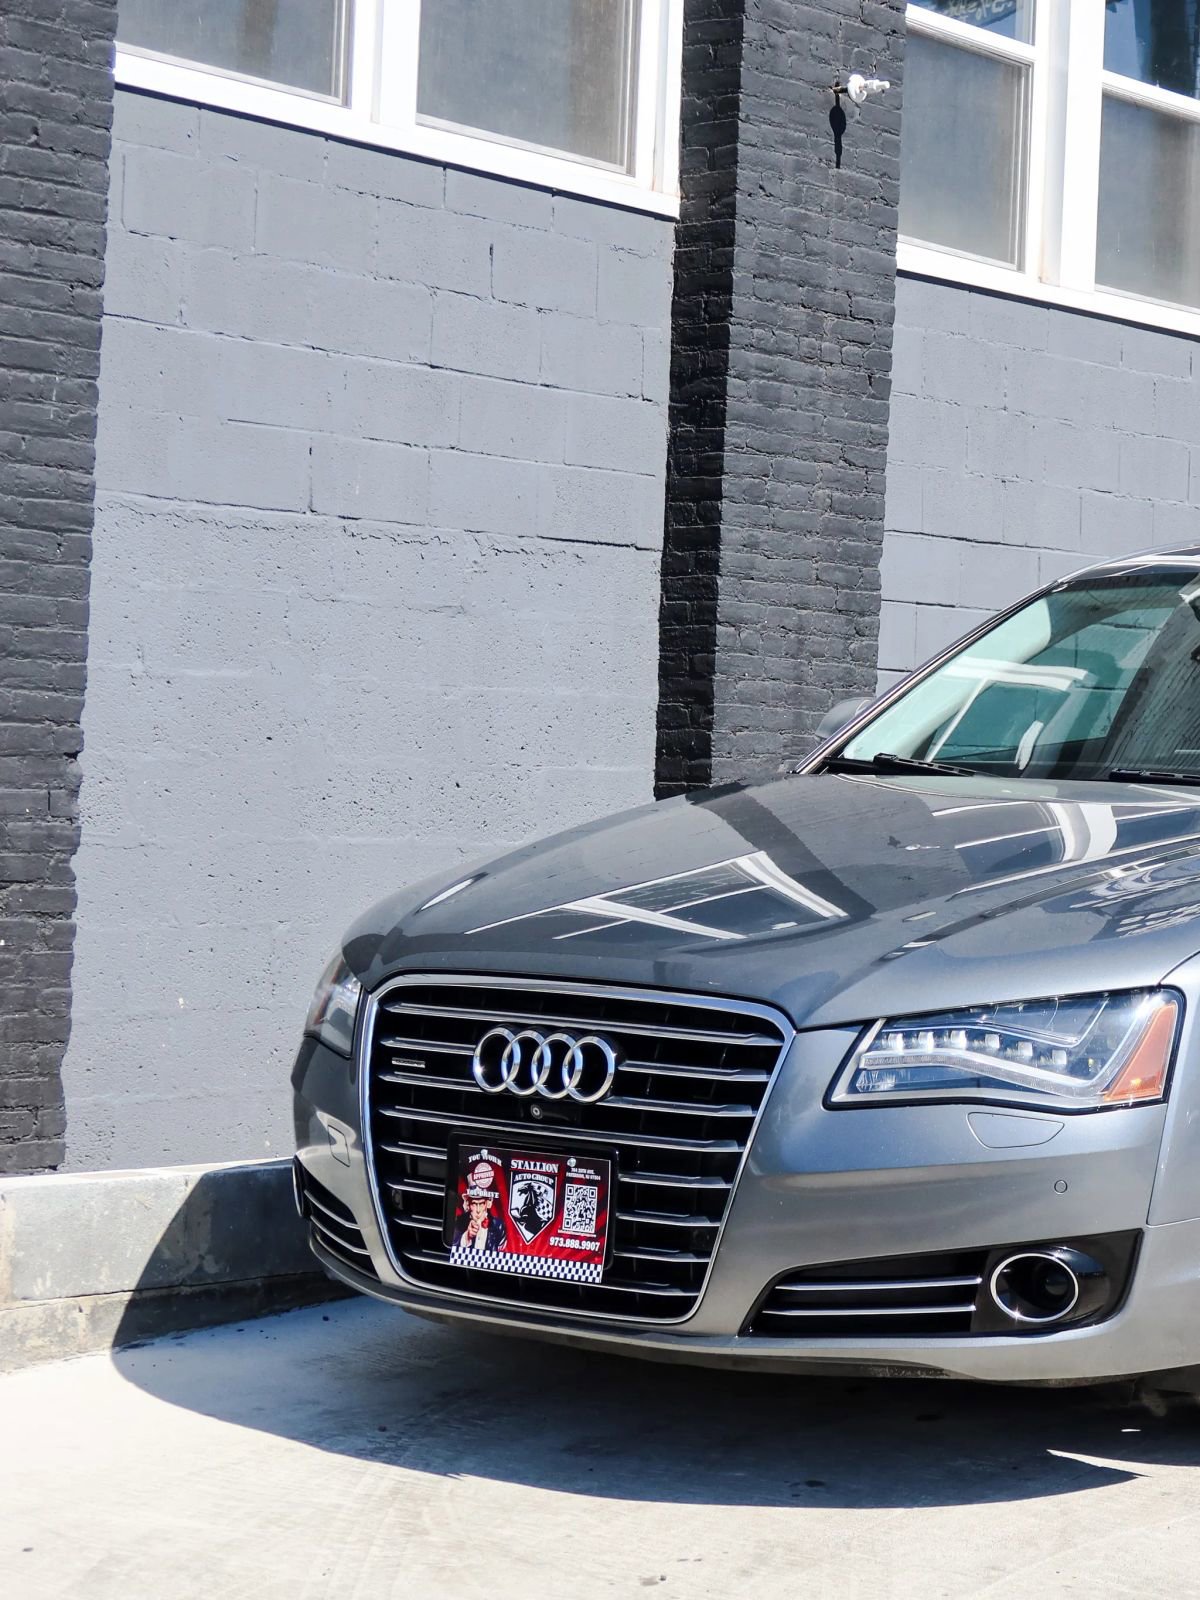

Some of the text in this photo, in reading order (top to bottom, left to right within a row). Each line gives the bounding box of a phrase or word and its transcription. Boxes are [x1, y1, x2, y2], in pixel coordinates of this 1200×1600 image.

[469, 1154, 481, 1163] YOU
[511, 1159, 559, 1173] STALLION
[514, 1173, 554, 1185] AUTO GROUP
[479, 1190, 500, 1198] DRIVE
[550, 1236, 601, 1251] 973.888.9907
